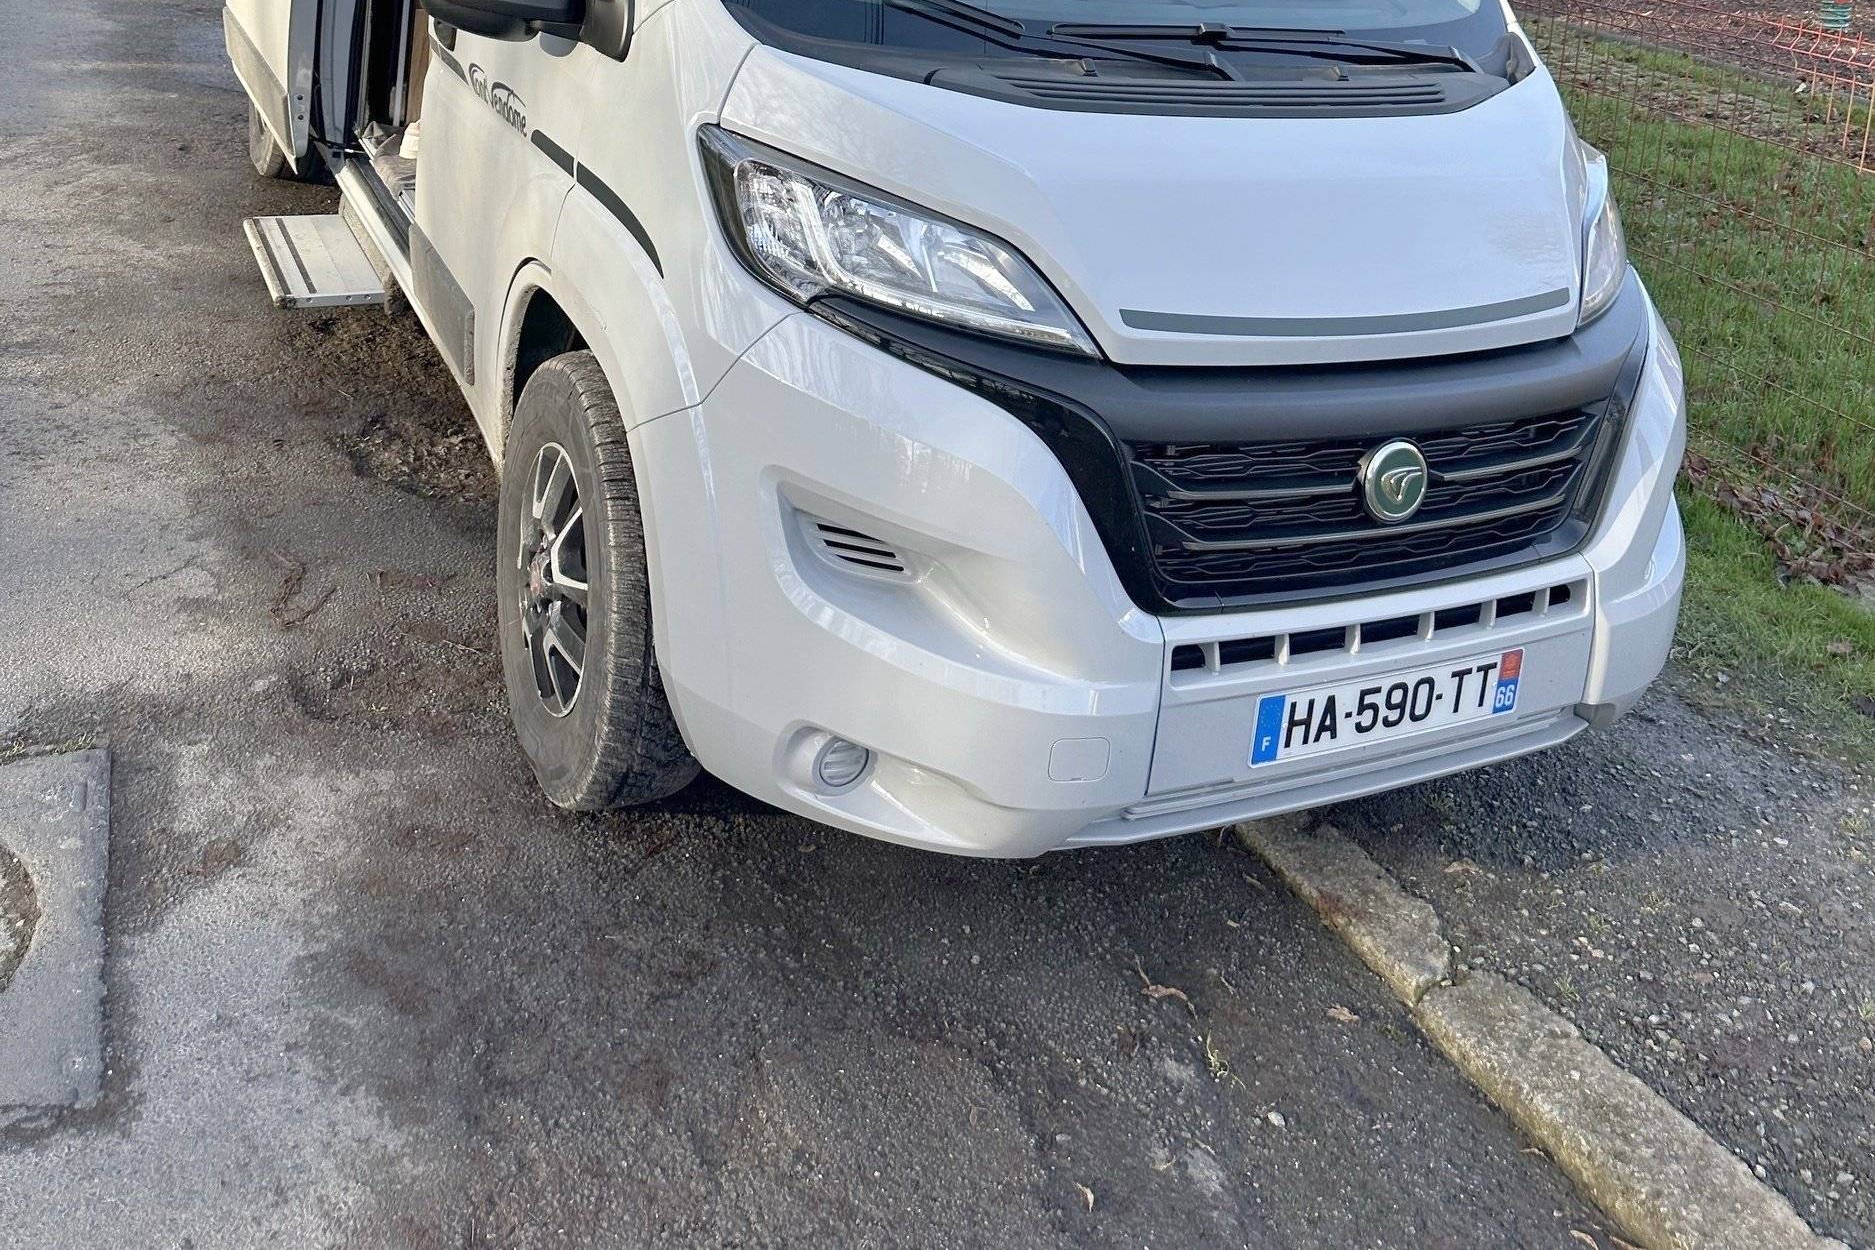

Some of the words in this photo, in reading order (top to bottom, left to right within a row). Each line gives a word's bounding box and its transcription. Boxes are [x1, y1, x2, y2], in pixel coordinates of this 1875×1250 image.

[1284, 661, 1498, 749] HA-590-TT
[1495, 683, 1515, 709] 66
[1261, 736, 1271, 752] F
